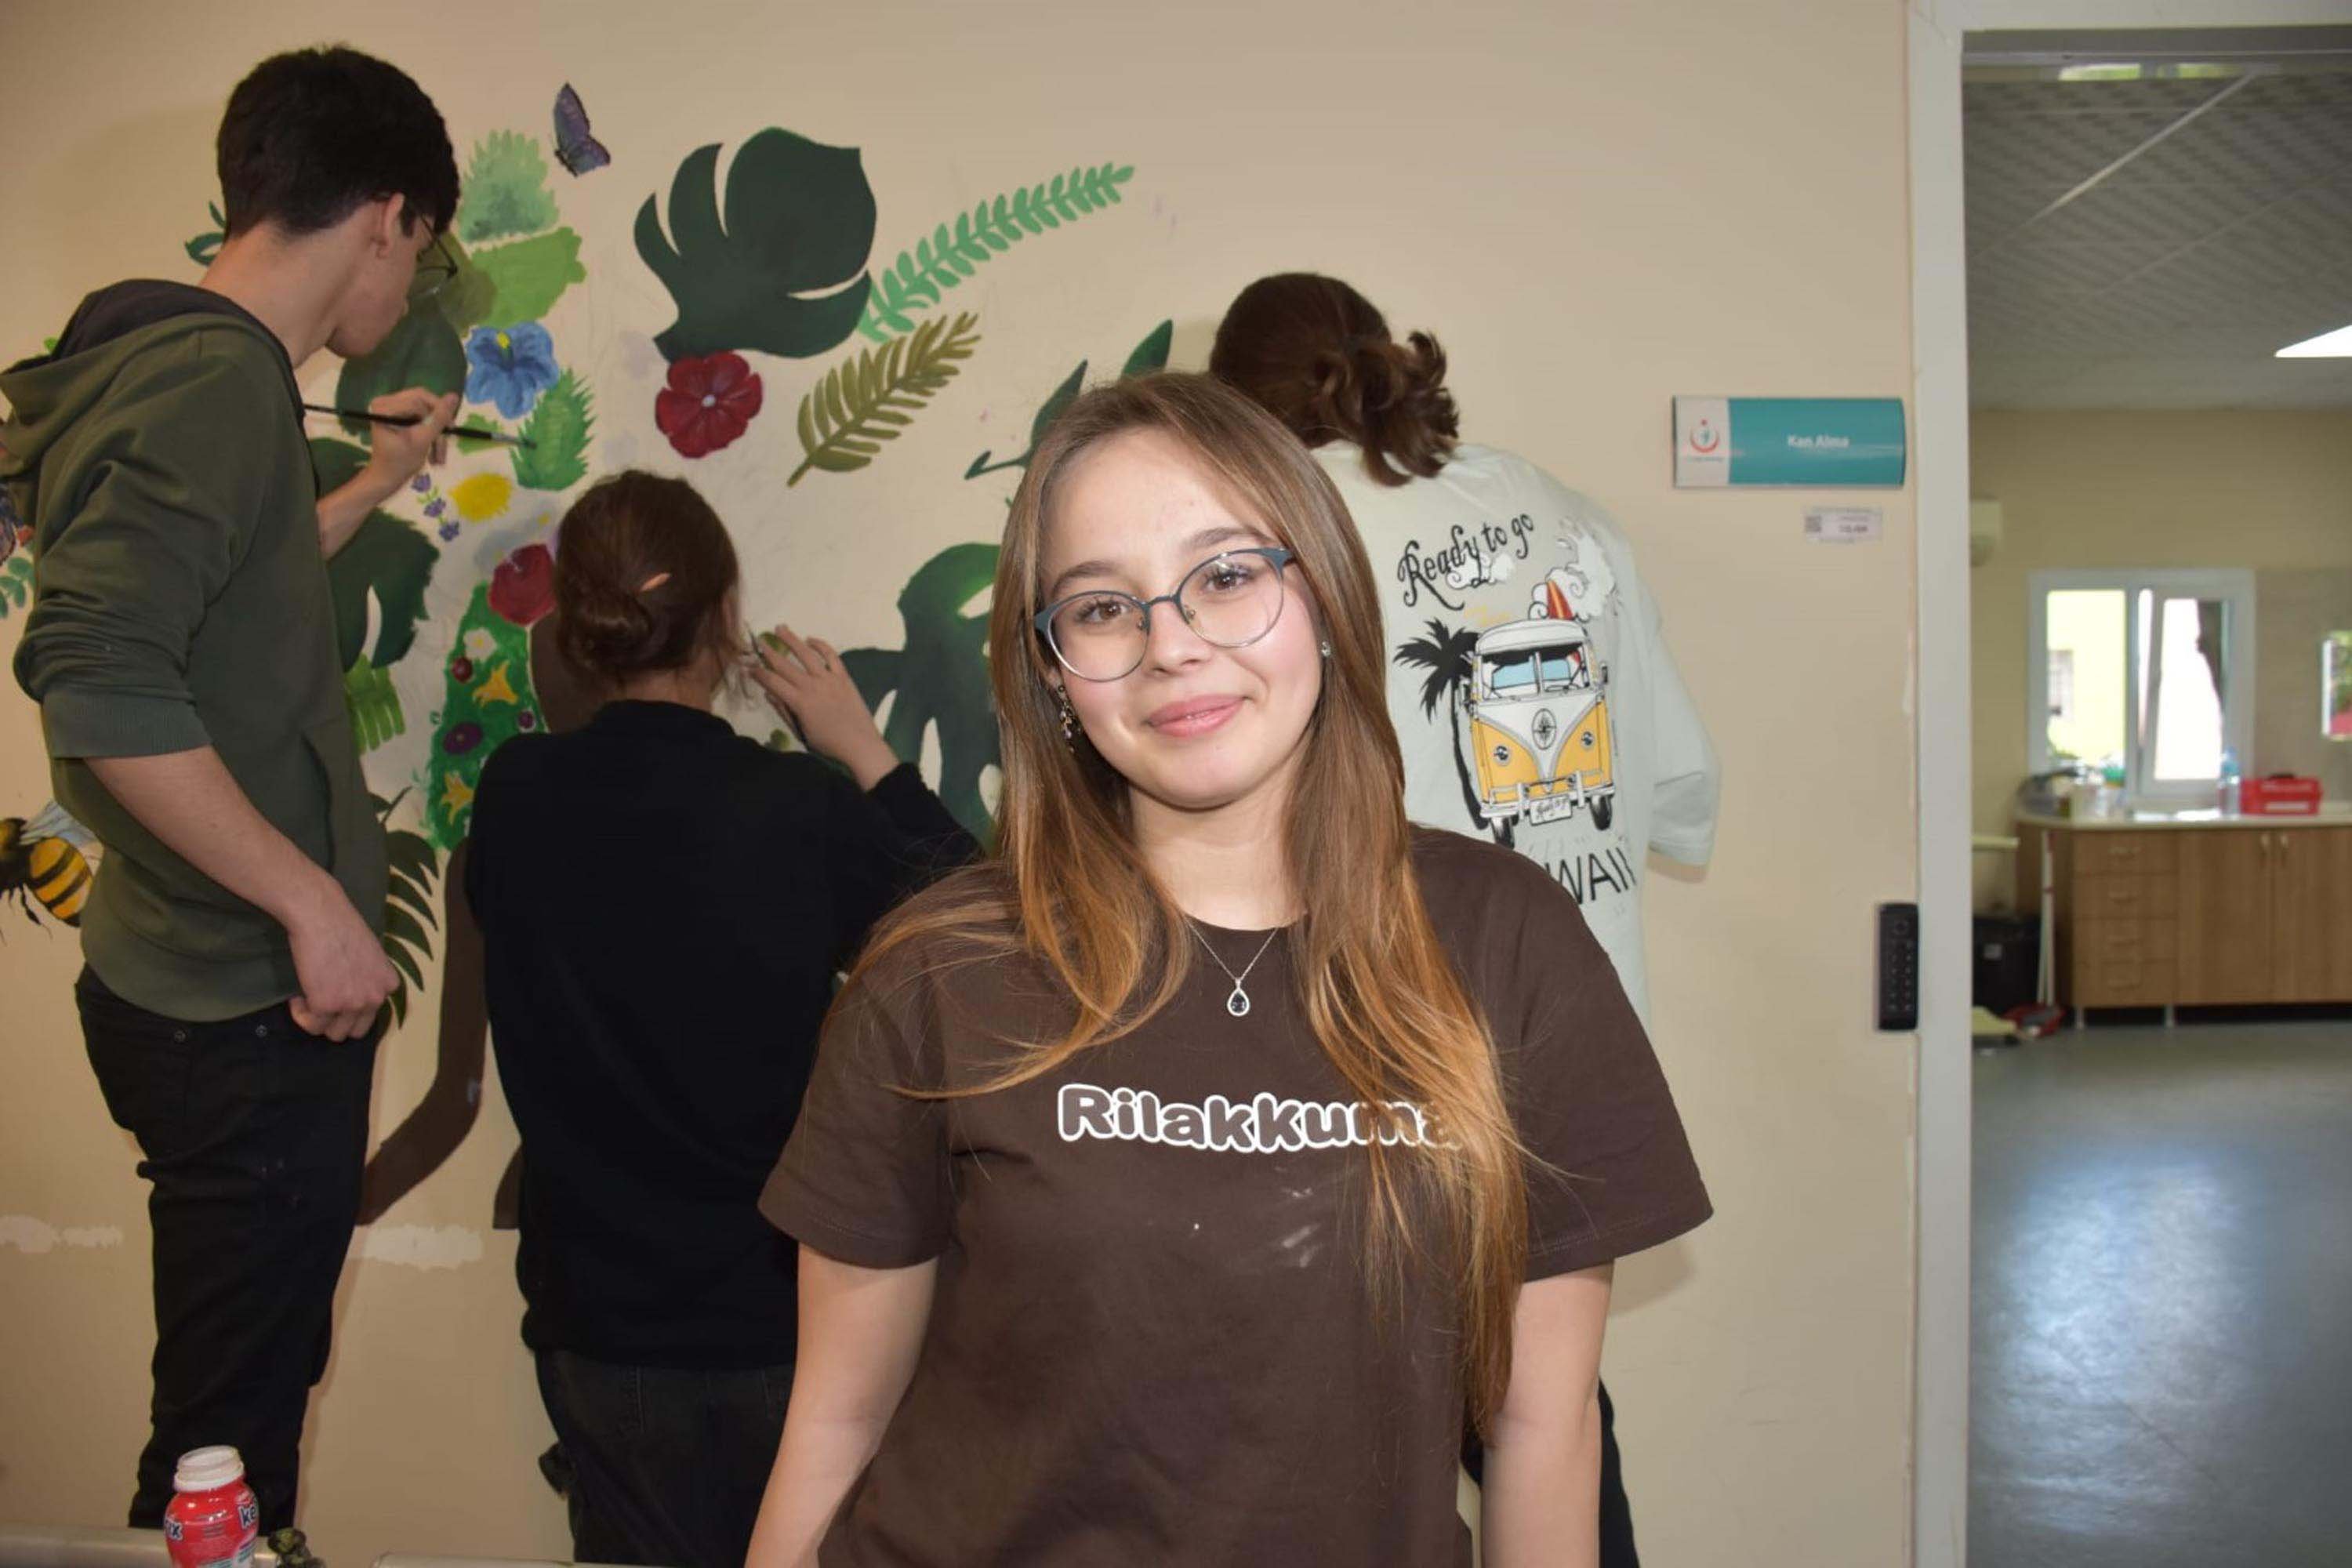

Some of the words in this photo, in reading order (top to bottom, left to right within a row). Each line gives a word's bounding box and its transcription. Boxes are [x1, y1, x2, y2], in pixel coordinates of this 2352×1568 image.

[1397, 524, 1490, 611] Ready
[1481, 522, 1508, 553] to
[1511, 514, 1534, 560] go
[1544, 847, 1637, 905] WAII
